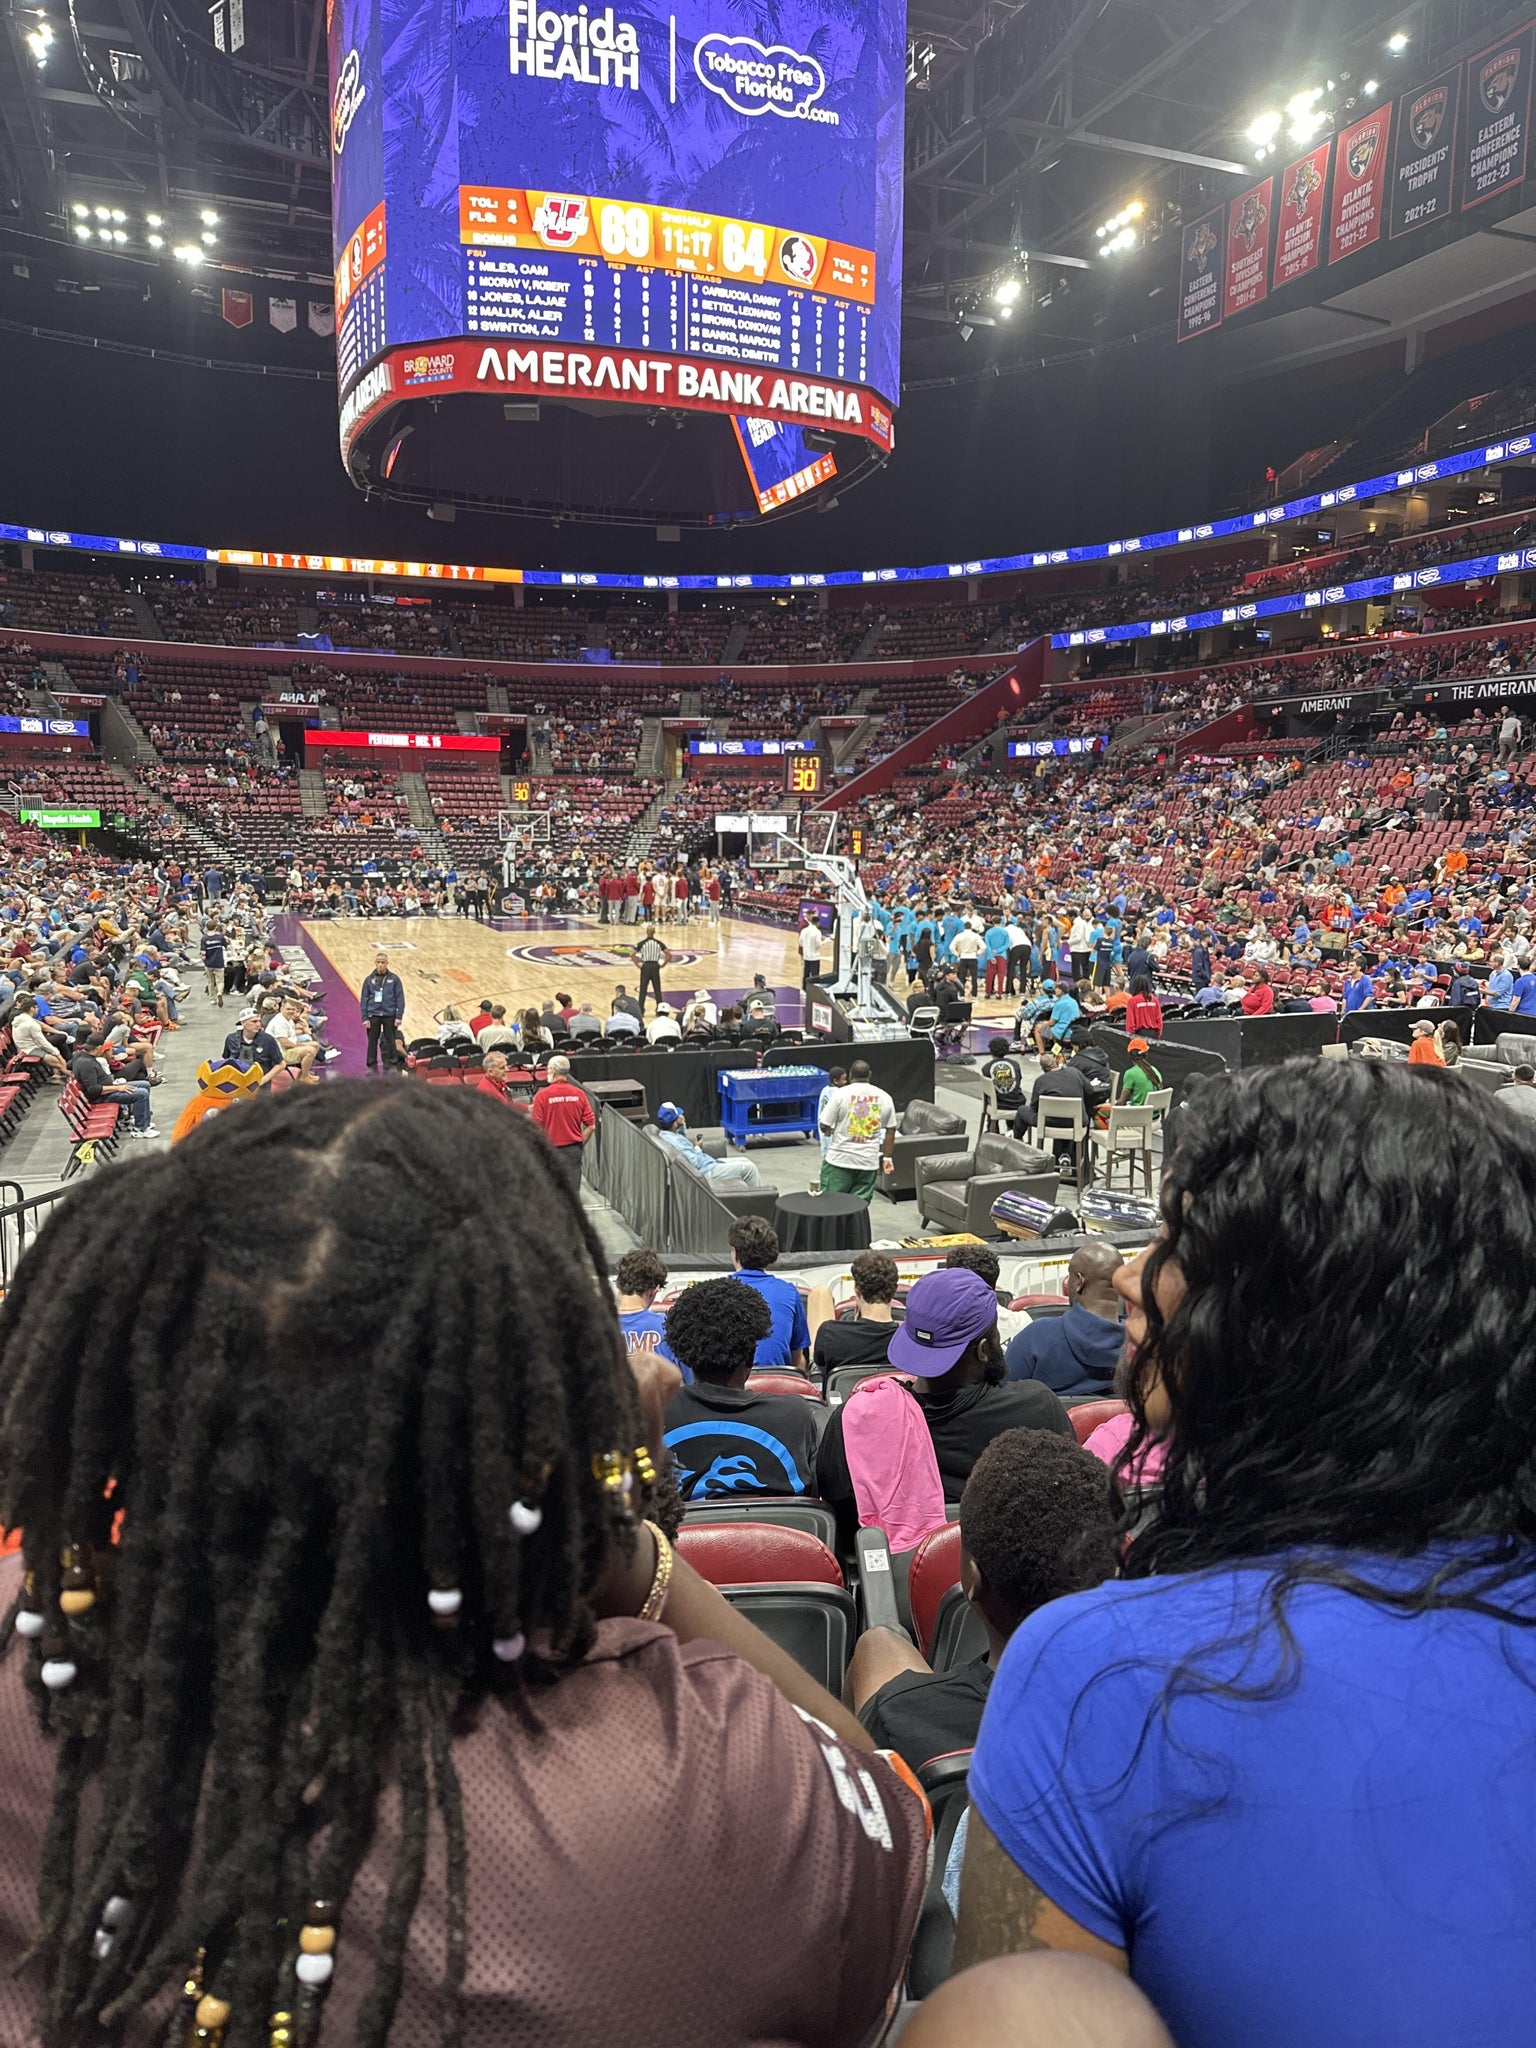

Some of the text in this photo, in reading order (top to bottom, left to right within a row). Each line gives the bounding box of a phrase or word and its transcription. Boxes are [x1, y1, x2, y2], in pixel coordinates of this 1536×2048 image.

[509, 0, 640, 54] Florida
[510, 37, 639, 91] HEALTH
[705, 51, 814, 87] Tobacco Free
[735, 75, 793, 102] Florida
[1478, 112, 1515, 143] EASTERN
[1470, 124, 1521, 163] CONFERENCE
[1470, 142, 1518, 178] CHAMPIONS
[1408, 166, 1439, 192] TROPHY
[1476, 162, 1511, 191] 2022-23
[1341, 180, 1373, 207] ATLANTIC
[1341, 195, 1371, 221] DIVISION
[1404, 198, 1437, 223] 2021-22
[601, 204, 649, 258] 69
[1285, 216, 1313, 240] ATLANTIC
[1336, 207, 1375, 238] CHAMPIONS
[663, 227, 712, 257] 11:17
[722, 222, 767, 277] 64
[1285, 229, 1311, 253] DIVISION
[1340, 226, 1368, 250] 2021-22
[467, 250, 486, 258] FSU
[1231, 247, 1263, 273] SOUTHEAST
[1280, 239, 1313, 266] CHAMPIONS
[1189, 272, 1212, 292] EASTERN
[1229, 271, 1263, 296] CHAMPIONS
[1235, 261, 1259, 283] DIVISION
[1184, 282, 1217, 307] CONFERENCE
[1184, 295, 1216, 319] CHAMPIONS
[356, 362, 388, 415] ARENA
[477, 347, 672, 392] AMERANT
[678, 366, 765, 407] BANK
[768, 378, 863, 424] ARENA
[1300, 697, 1352, 713] AMERANT
[1452, 686, 1474, 700] THE
[793, 769, 816, 791] 30
[514, 789, 528, 801] 30
